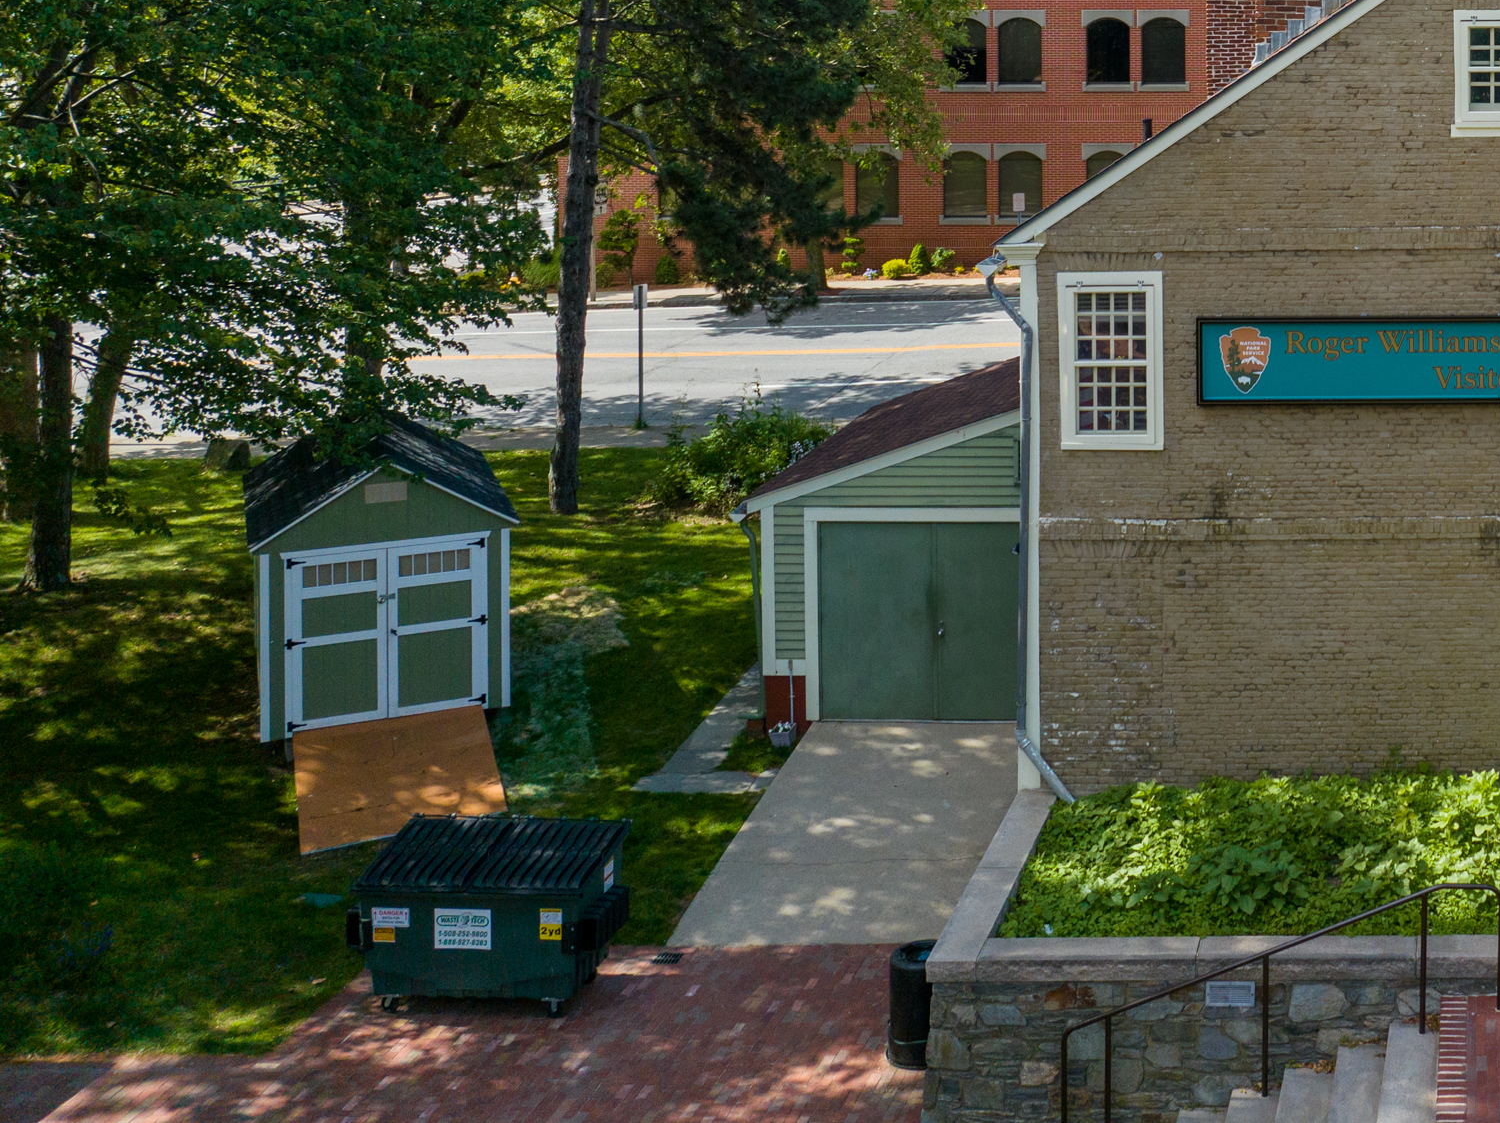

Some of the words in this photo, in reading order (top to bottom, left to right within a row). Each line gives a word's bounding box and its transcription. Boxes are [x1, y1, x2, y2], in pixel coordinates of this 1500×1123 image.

[1285, 330, 1369, 361] Roger
[441, 916, 460, 924] WASTE
[541, 926, 561, 937] 2yd
